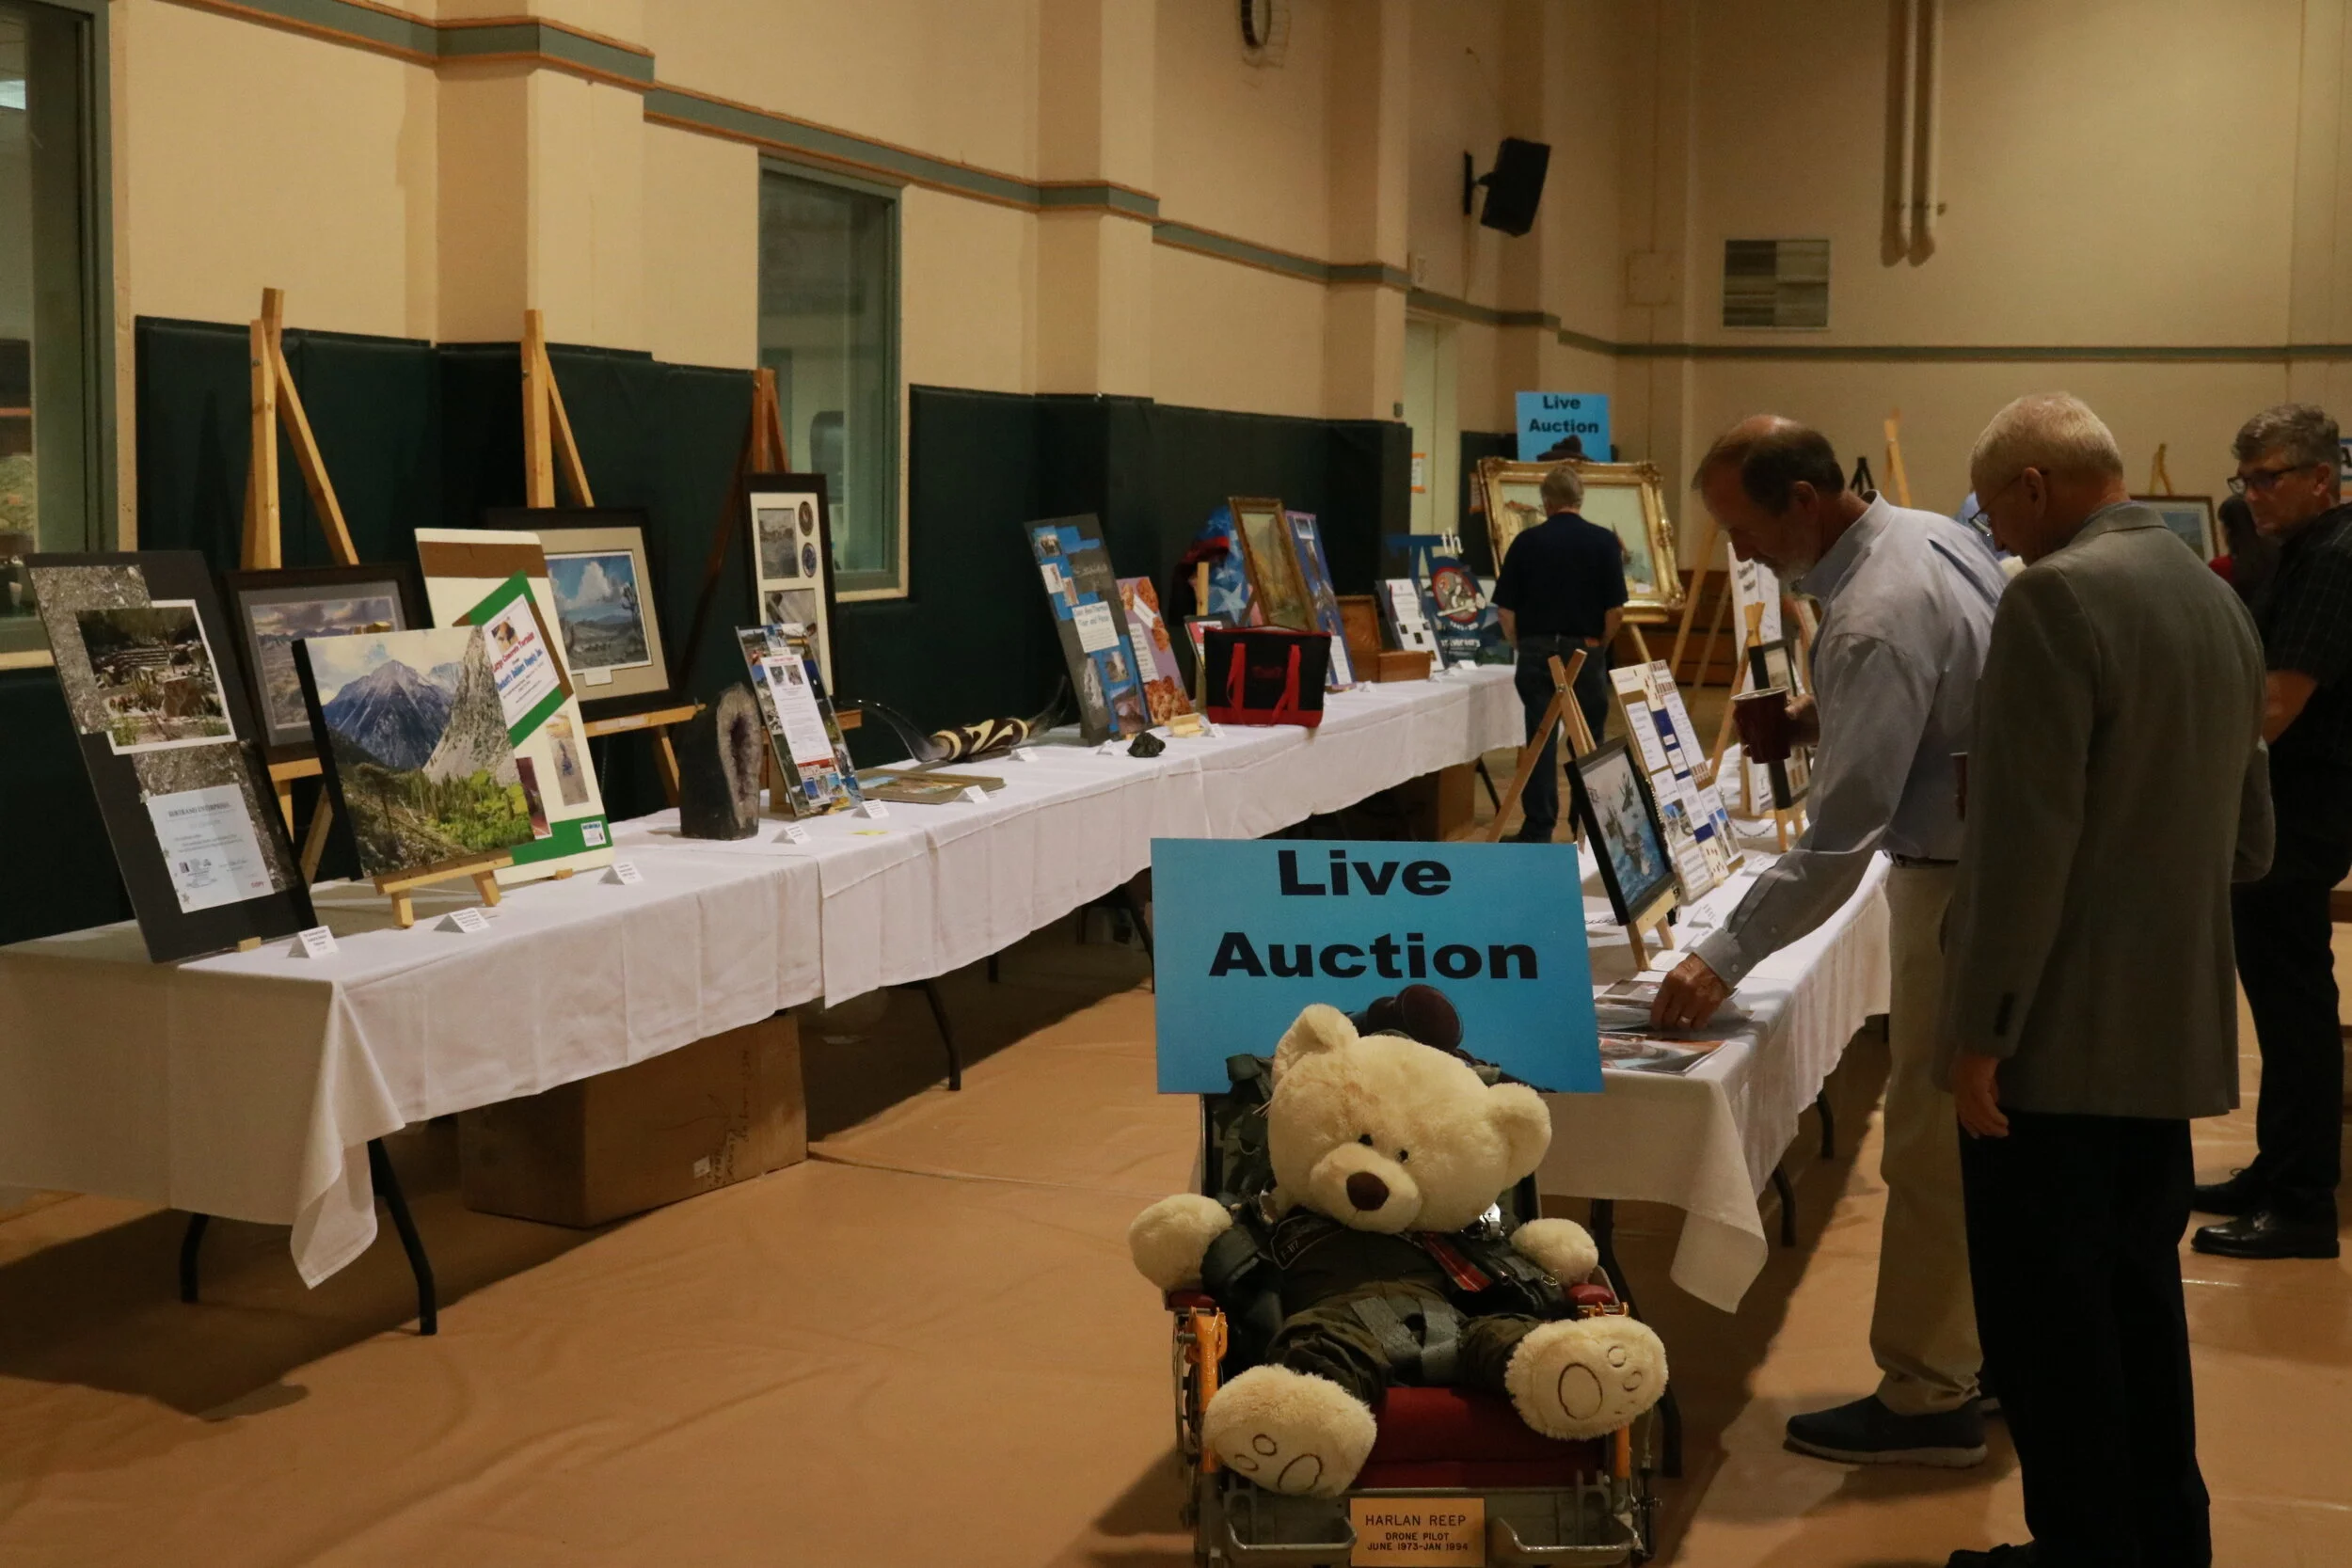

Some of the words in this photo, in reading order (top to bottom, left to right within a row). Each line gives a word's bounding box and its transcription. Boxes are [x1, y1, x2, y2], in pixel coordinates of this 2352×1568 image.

[1543, 395, 1581, 410] Live
[1529, 419, 1598, 434] Auction
[1277, 849, 1452, 895] Live
[1208, 931, 1538, 979] Auction
[1365, 1514, 1421, 1526] HARLAN
[1430, 1514, 1466, 1526] REEP
[1385, 1532, 1418, 1541] DRONE
[1422, 1532, 1450, 1541] PILOT
[1367, 1543, 1392, 1551] JUNE
[1397, 1543, 1441, 1551] 1973-JAN
